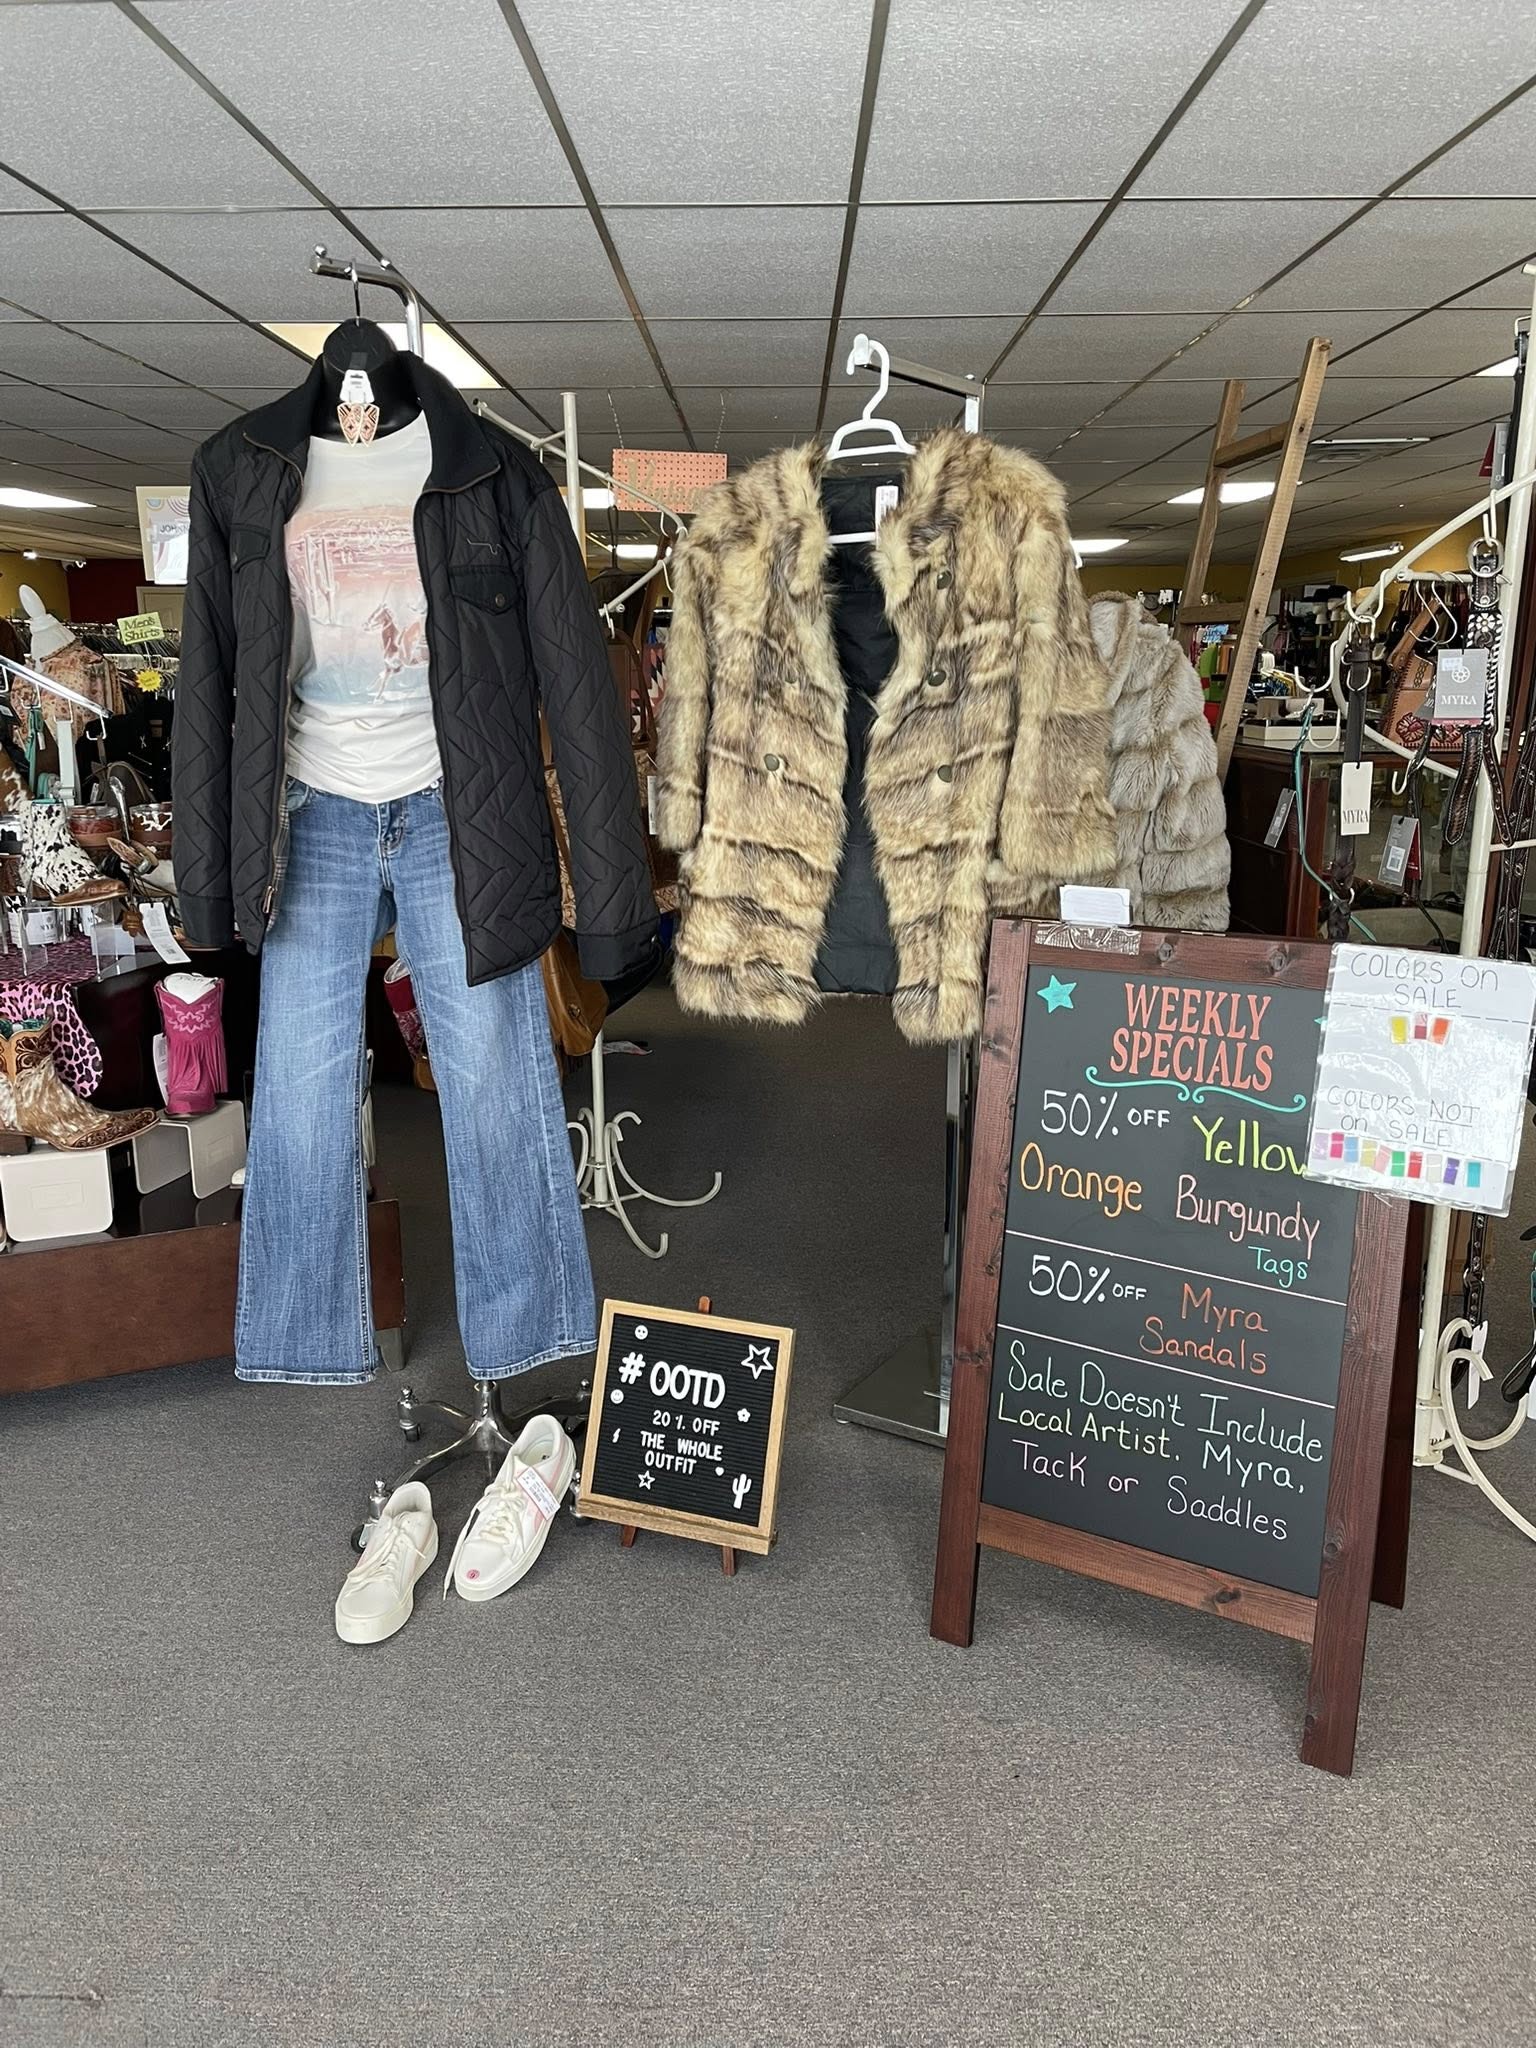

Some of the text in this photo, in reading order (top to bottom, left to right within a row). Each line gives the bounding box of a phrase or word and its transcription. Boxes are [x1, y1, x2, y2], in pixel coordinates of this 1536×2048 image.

[125, 629, 160, 641] Shirts
[1441, 695, 1477, 705] MYRA
[1342, 809, 1369, 824] MYRA
[1351, 952, 1444, 984] COLORS
[1124, 982, 1272, 1040] WEEKLY
[1395, 984, 1461, 1009] SALE
[1109, 1027, 1274, 1092] SPECIALS
[1041, 1089, 1119, 1139] 50%
[1127, 1108, 1170, 1128] OFF
[1327, 1085, 1480, 1123] COLORS NOT
[1389, 1120, 1452, 1147] SALE
[1020, 1142, 1320, 1260] Orange Burgundy
[1248, 1246, 1308, 1288] Tags
[1028, 1255, 1269, 1332] 50% OFF Myra
[1140, 1316, 1268, 1375] Sandals
[1008, 1340, 1324, 1462] Sale Doesn't Include
[640, 1431, 723, 1461] THE WHOLE
[692, 1417, 720, 1437] OFF
[998, 1392, 1073, 1436] Local
[1203, 1440, 1305, 1493] Myra,
[645, 1450, 697, 1475] OUTFIT
[1108, 1474, 1139, 1493] or
[1168, 1475, 1288, 1540] Saddles
